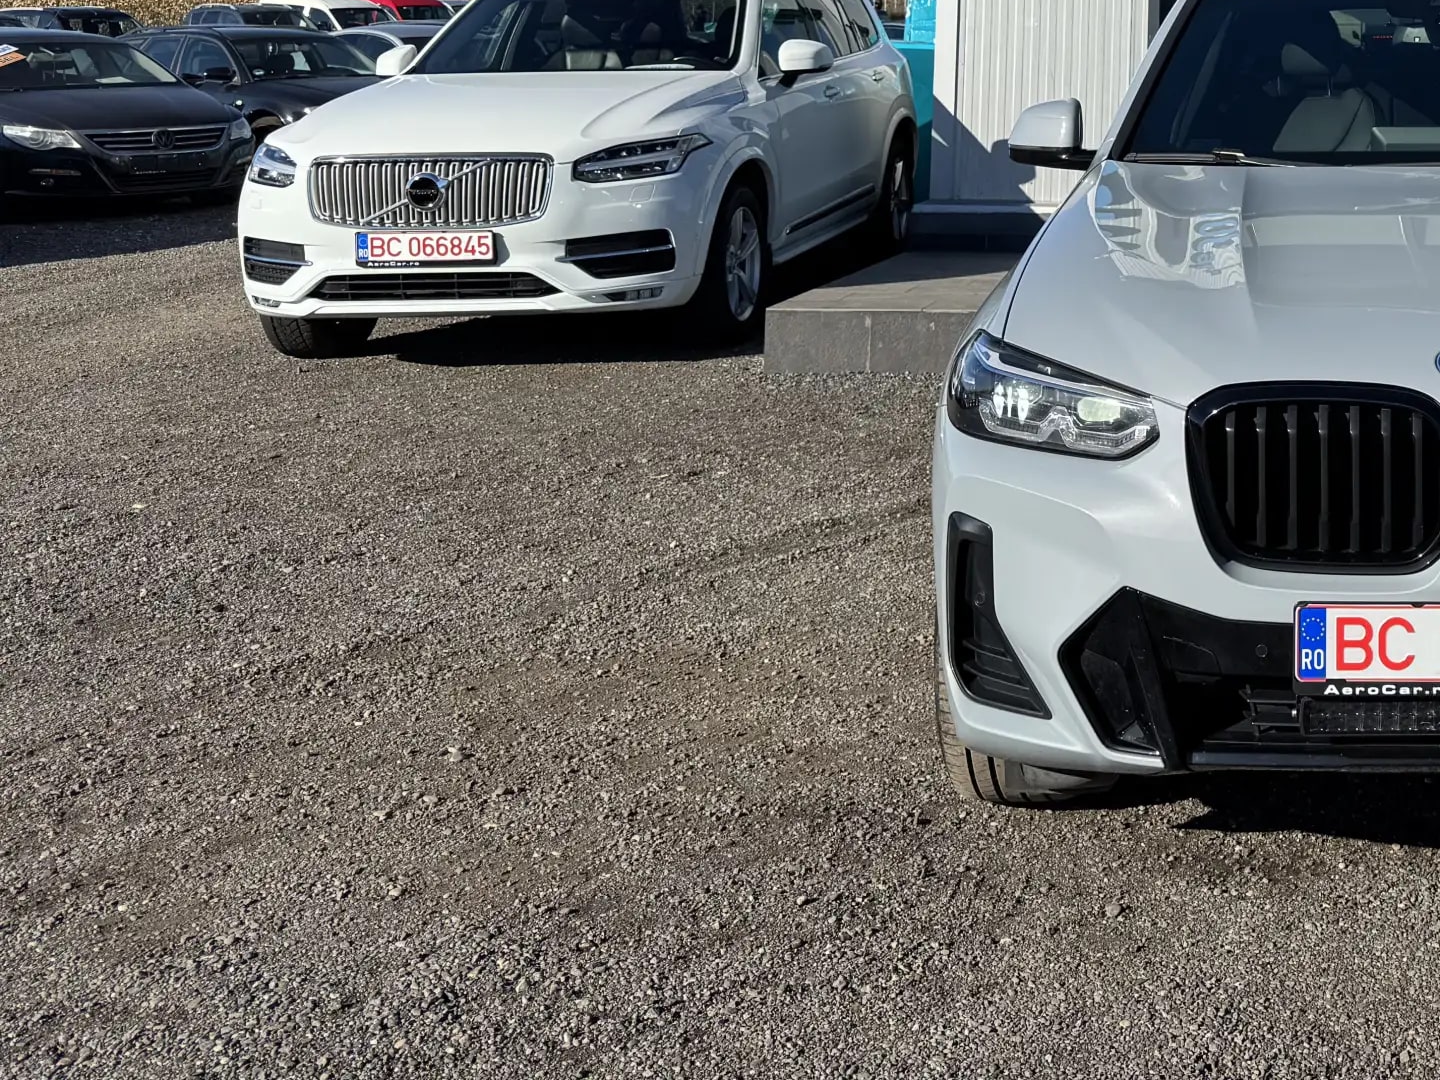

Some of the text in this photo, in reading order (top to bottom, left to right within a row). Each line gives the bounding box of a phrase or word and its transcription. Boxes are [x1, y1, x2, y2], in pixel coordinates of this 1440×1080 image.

[358, 249, 368, 258] RO
[370, 235, 490, 258] BC 066845
[1336, 617, 1416, 671] BC
[1301, 649, 1324, 670] RO
